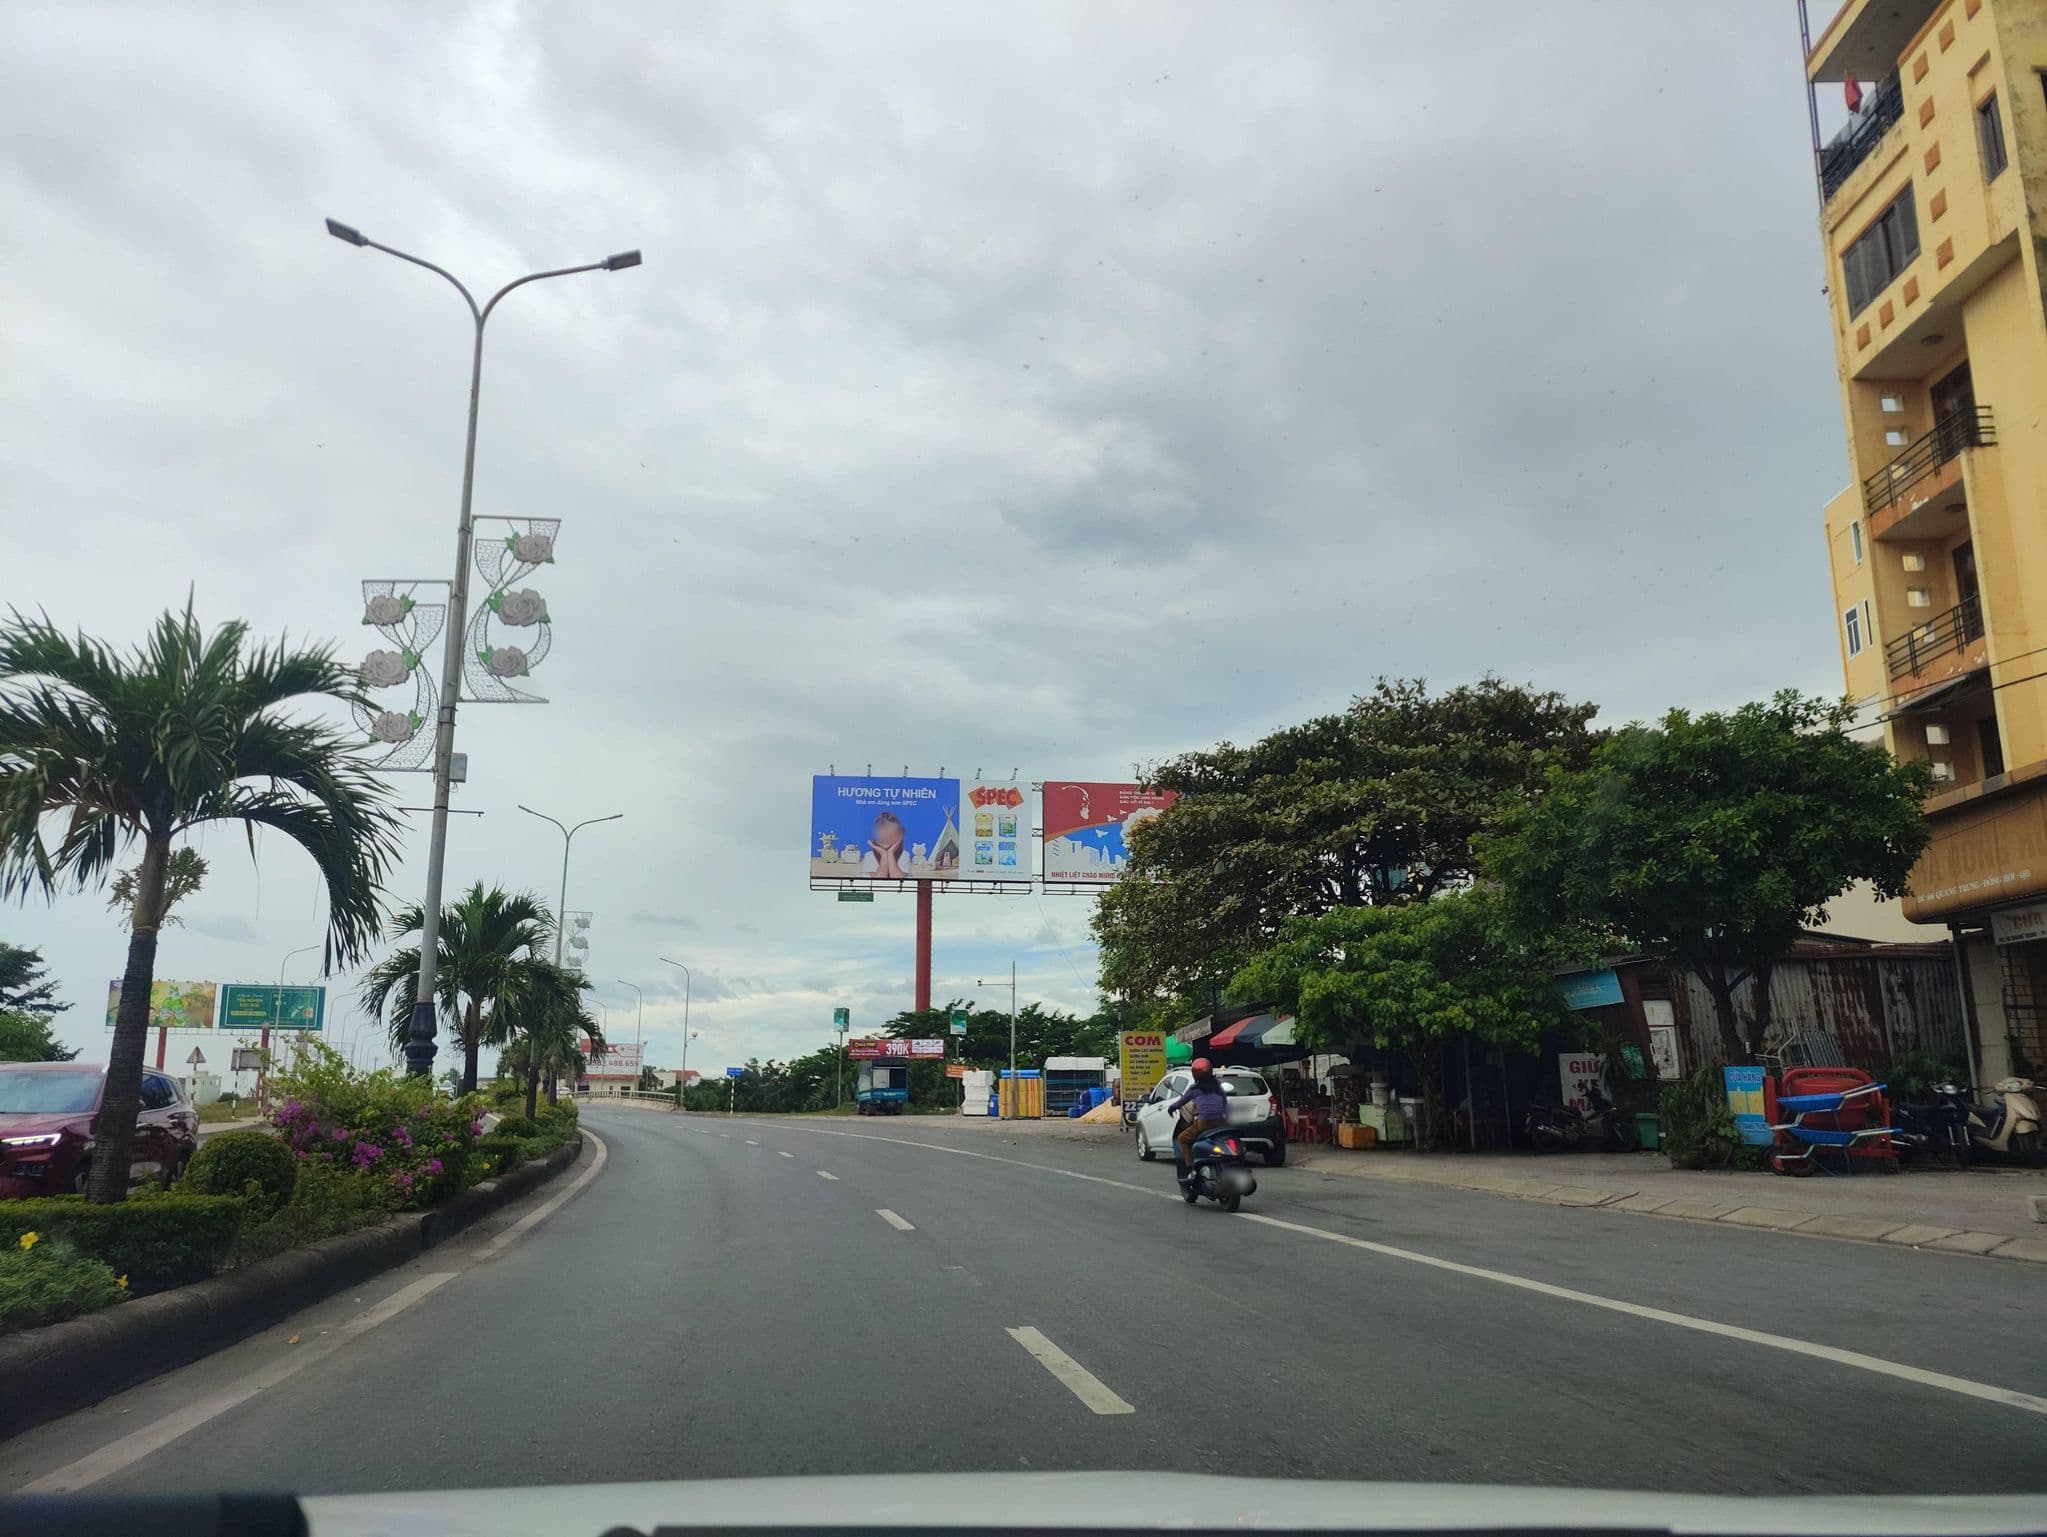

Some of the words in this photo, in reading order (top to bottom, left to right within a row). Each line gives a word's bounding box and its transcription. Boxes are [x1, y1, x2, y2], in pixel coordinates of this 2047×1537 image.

[837, 787, 881, 798] HƯƠNG
[884, 788, 900, 800] TỰ
[902, 787, 937, 799] NHIÊN
[976, 787, 1017, 806] SPEC
[1125, 1035, 1161, 1046] CƠM
[886, 1043, 910, 1056] 390K
